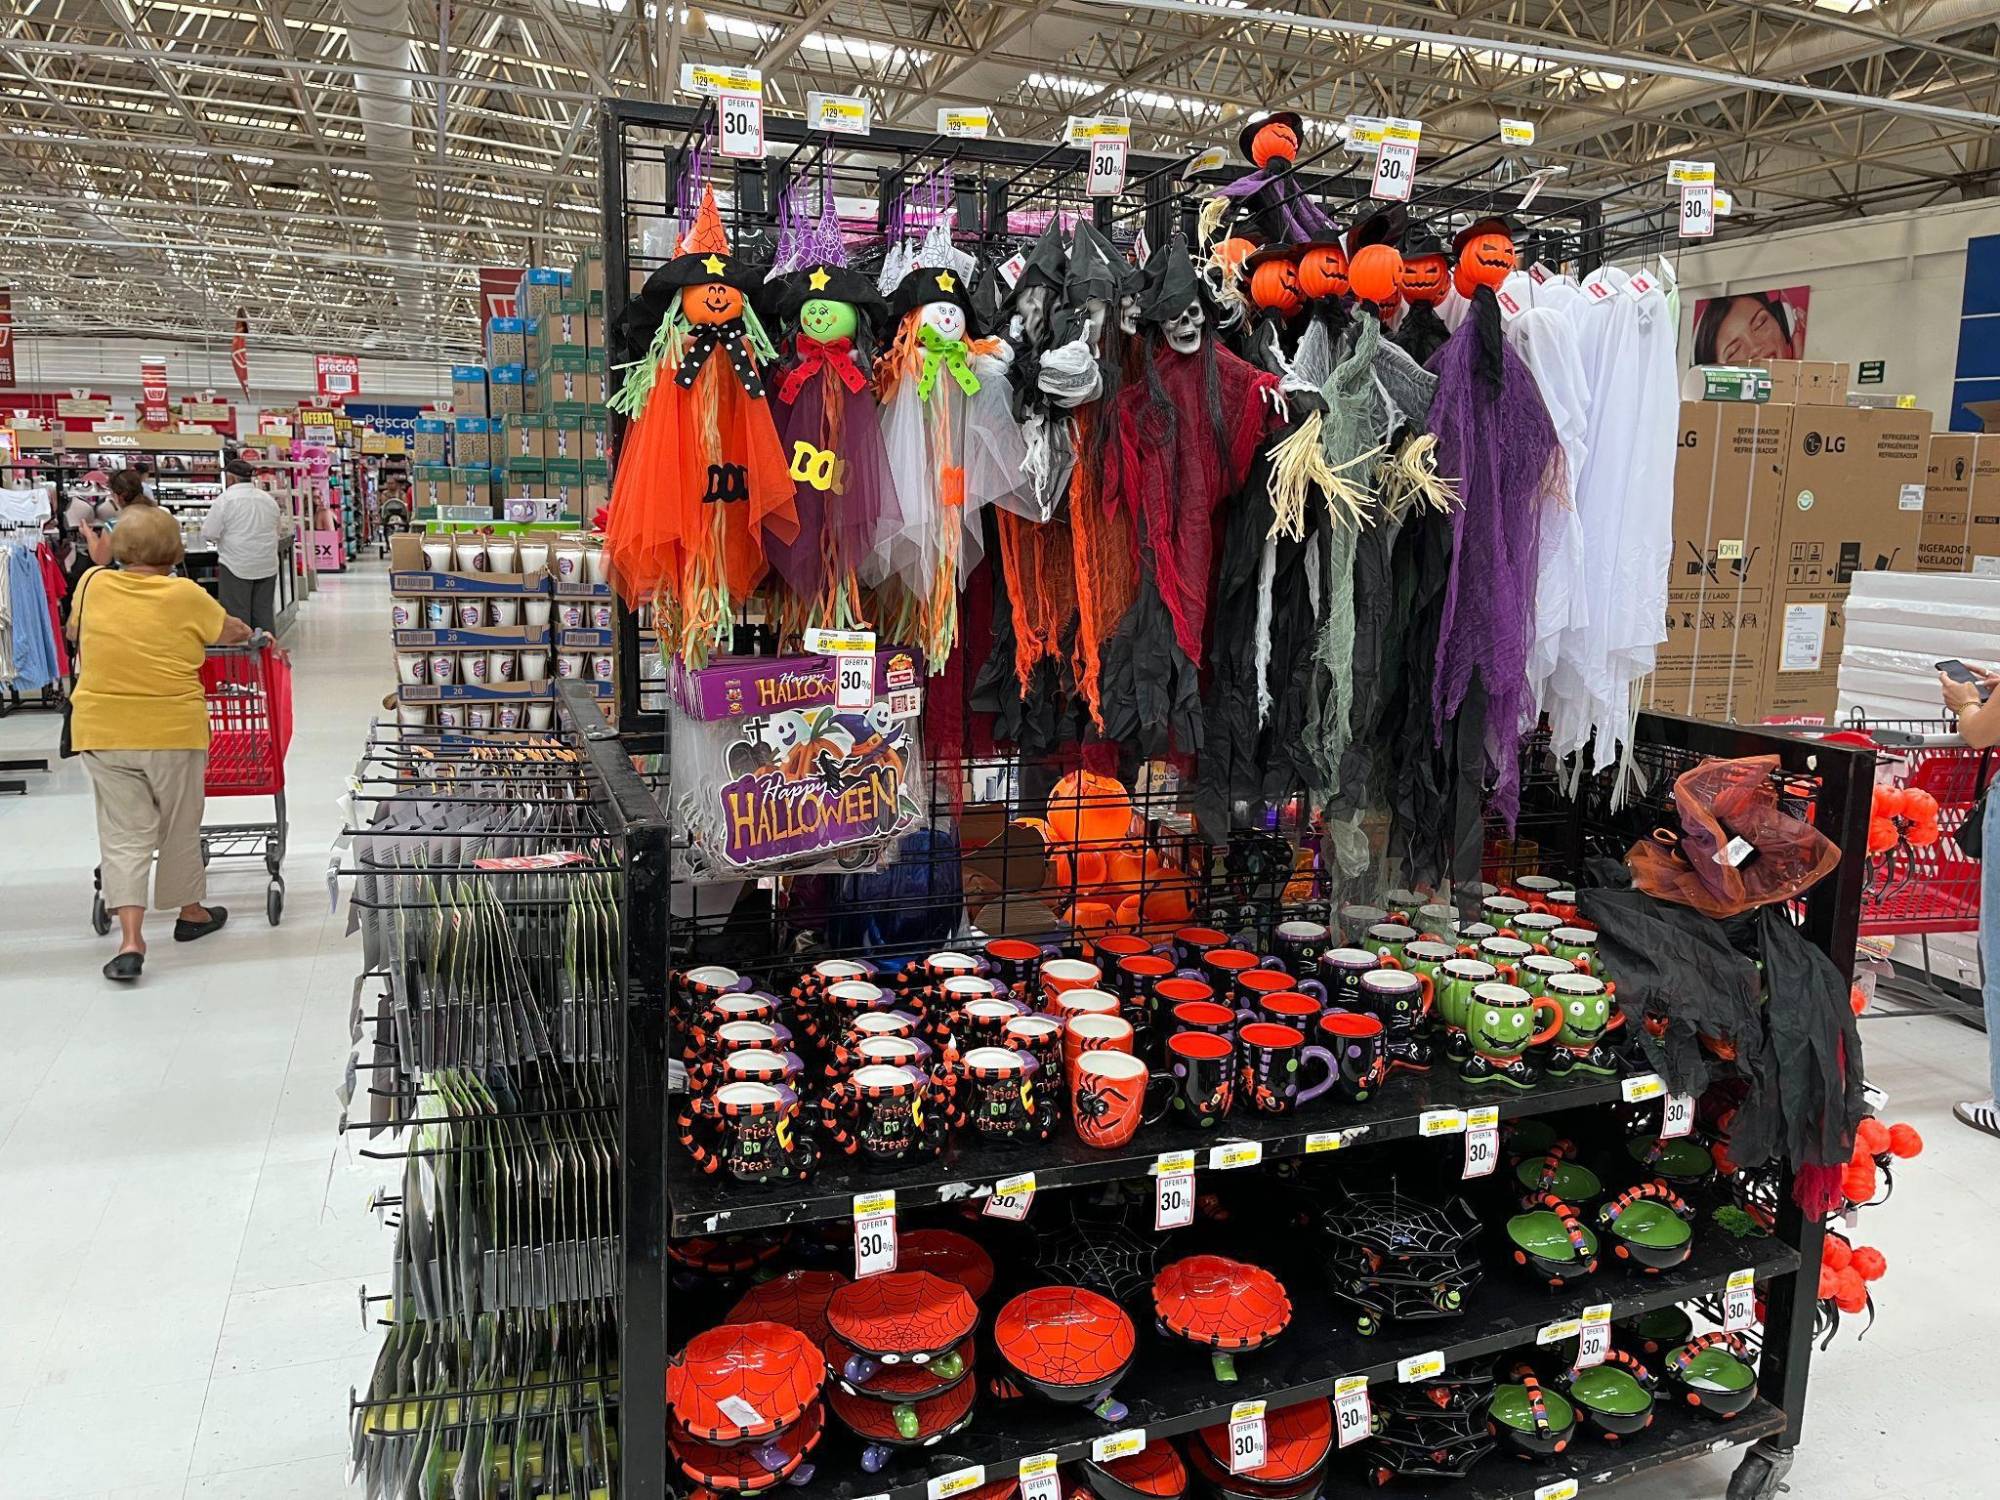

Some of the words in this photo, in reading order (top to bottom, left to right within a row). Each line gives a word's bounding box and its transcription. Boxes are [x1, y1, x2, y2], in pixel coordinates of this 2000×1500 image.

[727, 99, 755, 108] OFERTA
[825, 107, 838, 118] 129
[724, 112, 760, 136] 30%
[949, 121, 961, 131] 129
[1386, 147, 1410, 156] OFERTA
[1094, 156, 1123, 175] 30%
[1379, 159, 1409, 181] 30%
[1685, 200, 1712, 218] 30%
[318, 363, 358, 374] precios
[302, 412, 334, 425] OFERTA
[1738, 427, 1780, 435] REFRIERATOR
[1825, 436, 1846, 453] LG
[445, 580, 455, 588] 20
[1713, 592, 1730, 600] LADO
[447, 634, 458, 642] 20
[779, 671, 826, 687] Happy
[841, 671, 871, 690] 30%
[755, 679, 836, 706] HALLOW
[761, 777, 828, 808] Happy
[729, 770, 897, 850] HALLOWEEN
[981, 1085, 1020, 1101] Trick
[873, 1101, 913, 1120] Trick
[991, 1102, 1007, 1115] or
[734, 1120, 776, 1140] Trick
[884, 1120, 899, 1135] or
[976, 1117, 1017, 1131] Treat
[1472, 1131, 1492, 1140] OFERTA
[744, 1142, 761, 1155] or
[868, 1137, 910, 1151] Treat
[1470, 1143, 1494, 1161] 30%
[727, 1156, 774, 1173] Treat
[1164, 1179, 1187, 1187] OFERTA
[992, 1195, 1024, 1210] 30%
[1161, 1191, 1190, 1211] 30%
[862, 1220, 888, 1230] OFERTA
[860, 1234, 893, 1257] 30%
[1728, 1303, 1751, 1319] 30%
[1587, 1327, 1605, 1335] OFERTA
[1341, 1396, 1362, 1407] OFERTA
[1341, 1409, 1367, 1430] 30%
[1236, 1422, 1258, 1432] OFERTA
[1235, 1435, 1264, 1456] 30%
[942, 1482, 954, 1491] 349
[1029, 1479, 1052, 1490] OFERTA
